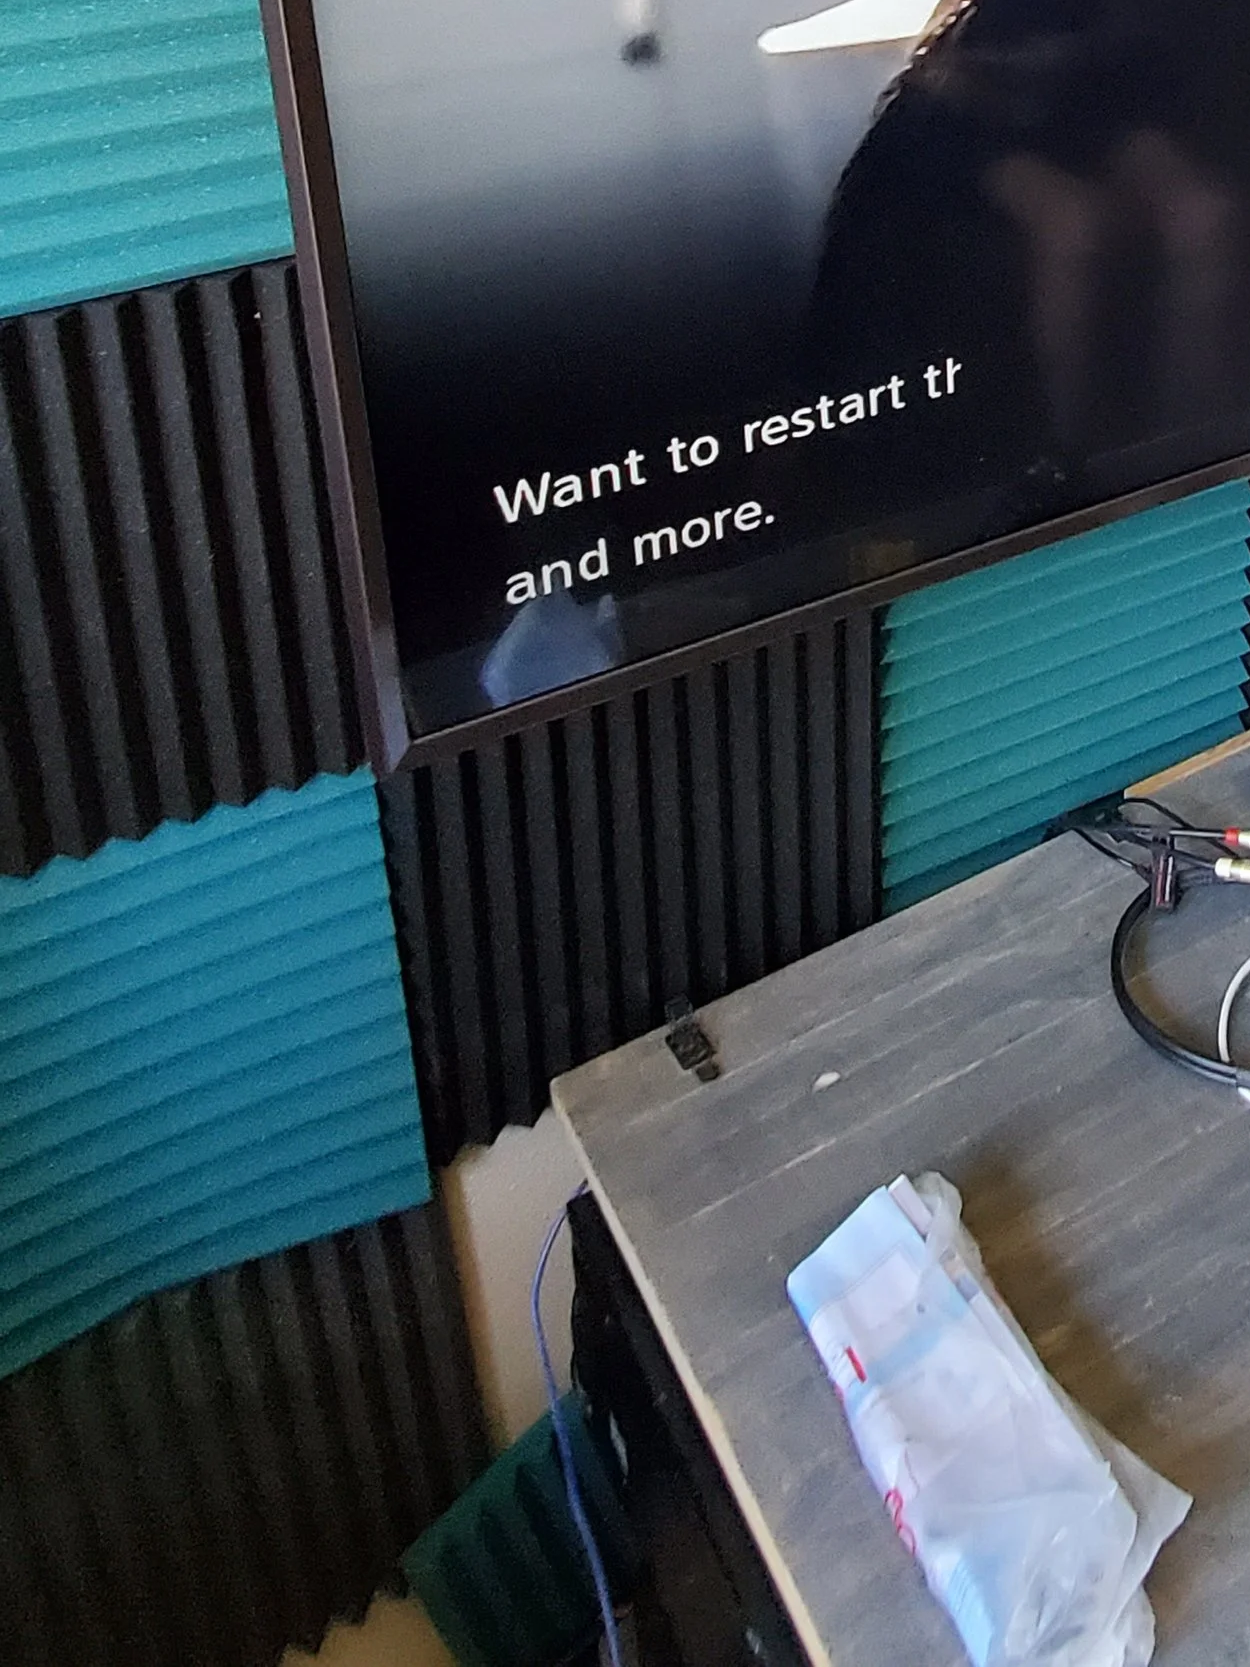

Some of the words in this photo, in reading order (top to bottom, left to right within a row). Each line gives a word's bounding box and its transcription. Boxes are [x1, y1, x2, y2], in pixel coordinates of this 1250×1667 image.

[494, 449, 646, 524] Want
[666, 435, 719, 473] to
[743, 374, 905, 453] restart
[506, 538, 609, 605] and
[633, 500, 774, 565] more.
